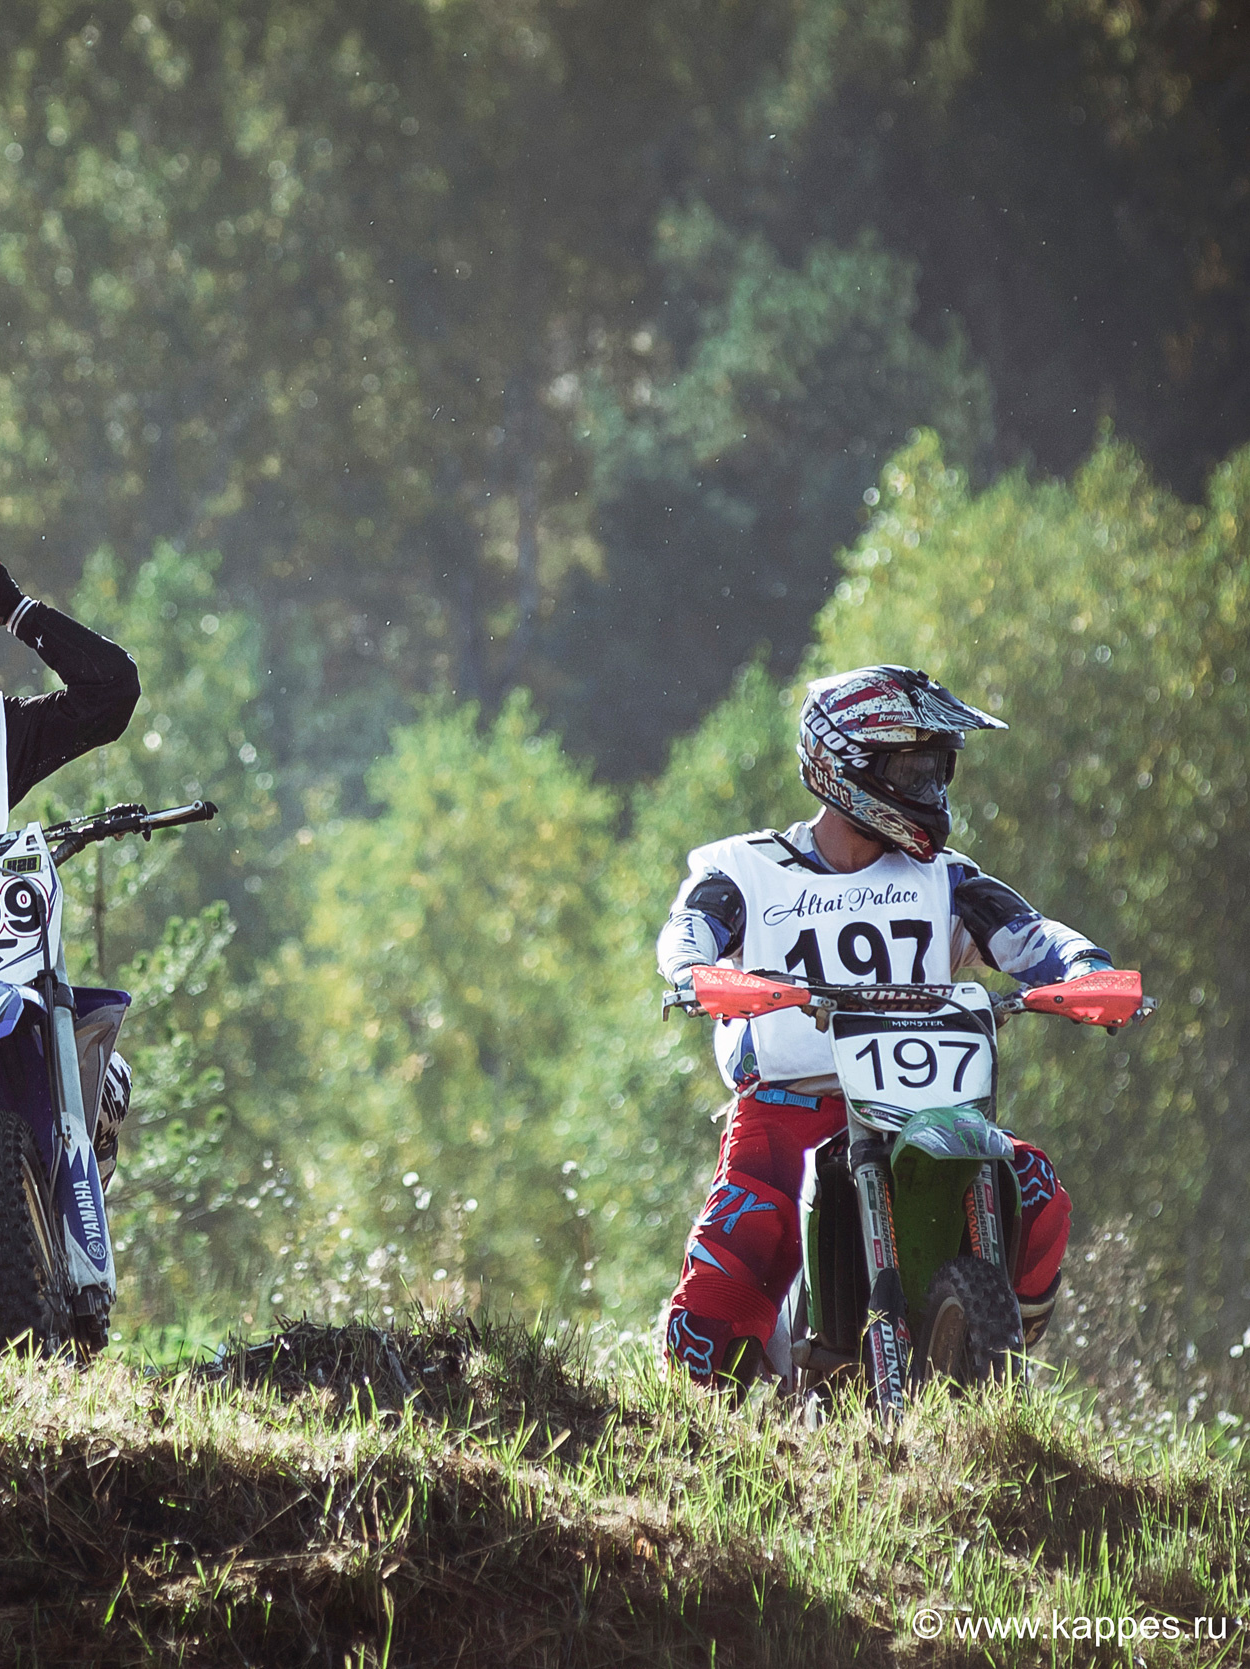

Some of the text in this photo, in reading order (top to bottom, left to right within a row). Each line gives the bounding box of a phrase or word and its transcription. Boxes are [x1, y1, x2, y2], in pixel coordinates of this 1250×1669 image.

[763, 883, 919, 926] Altai Palace
[784, 919, 934, 986] 197
[855, 1037, 981, 1093] 197
[73, 1179, 102, 1241] YAMAHA
[976, 1184, 989, 1237] SUSPENSION
